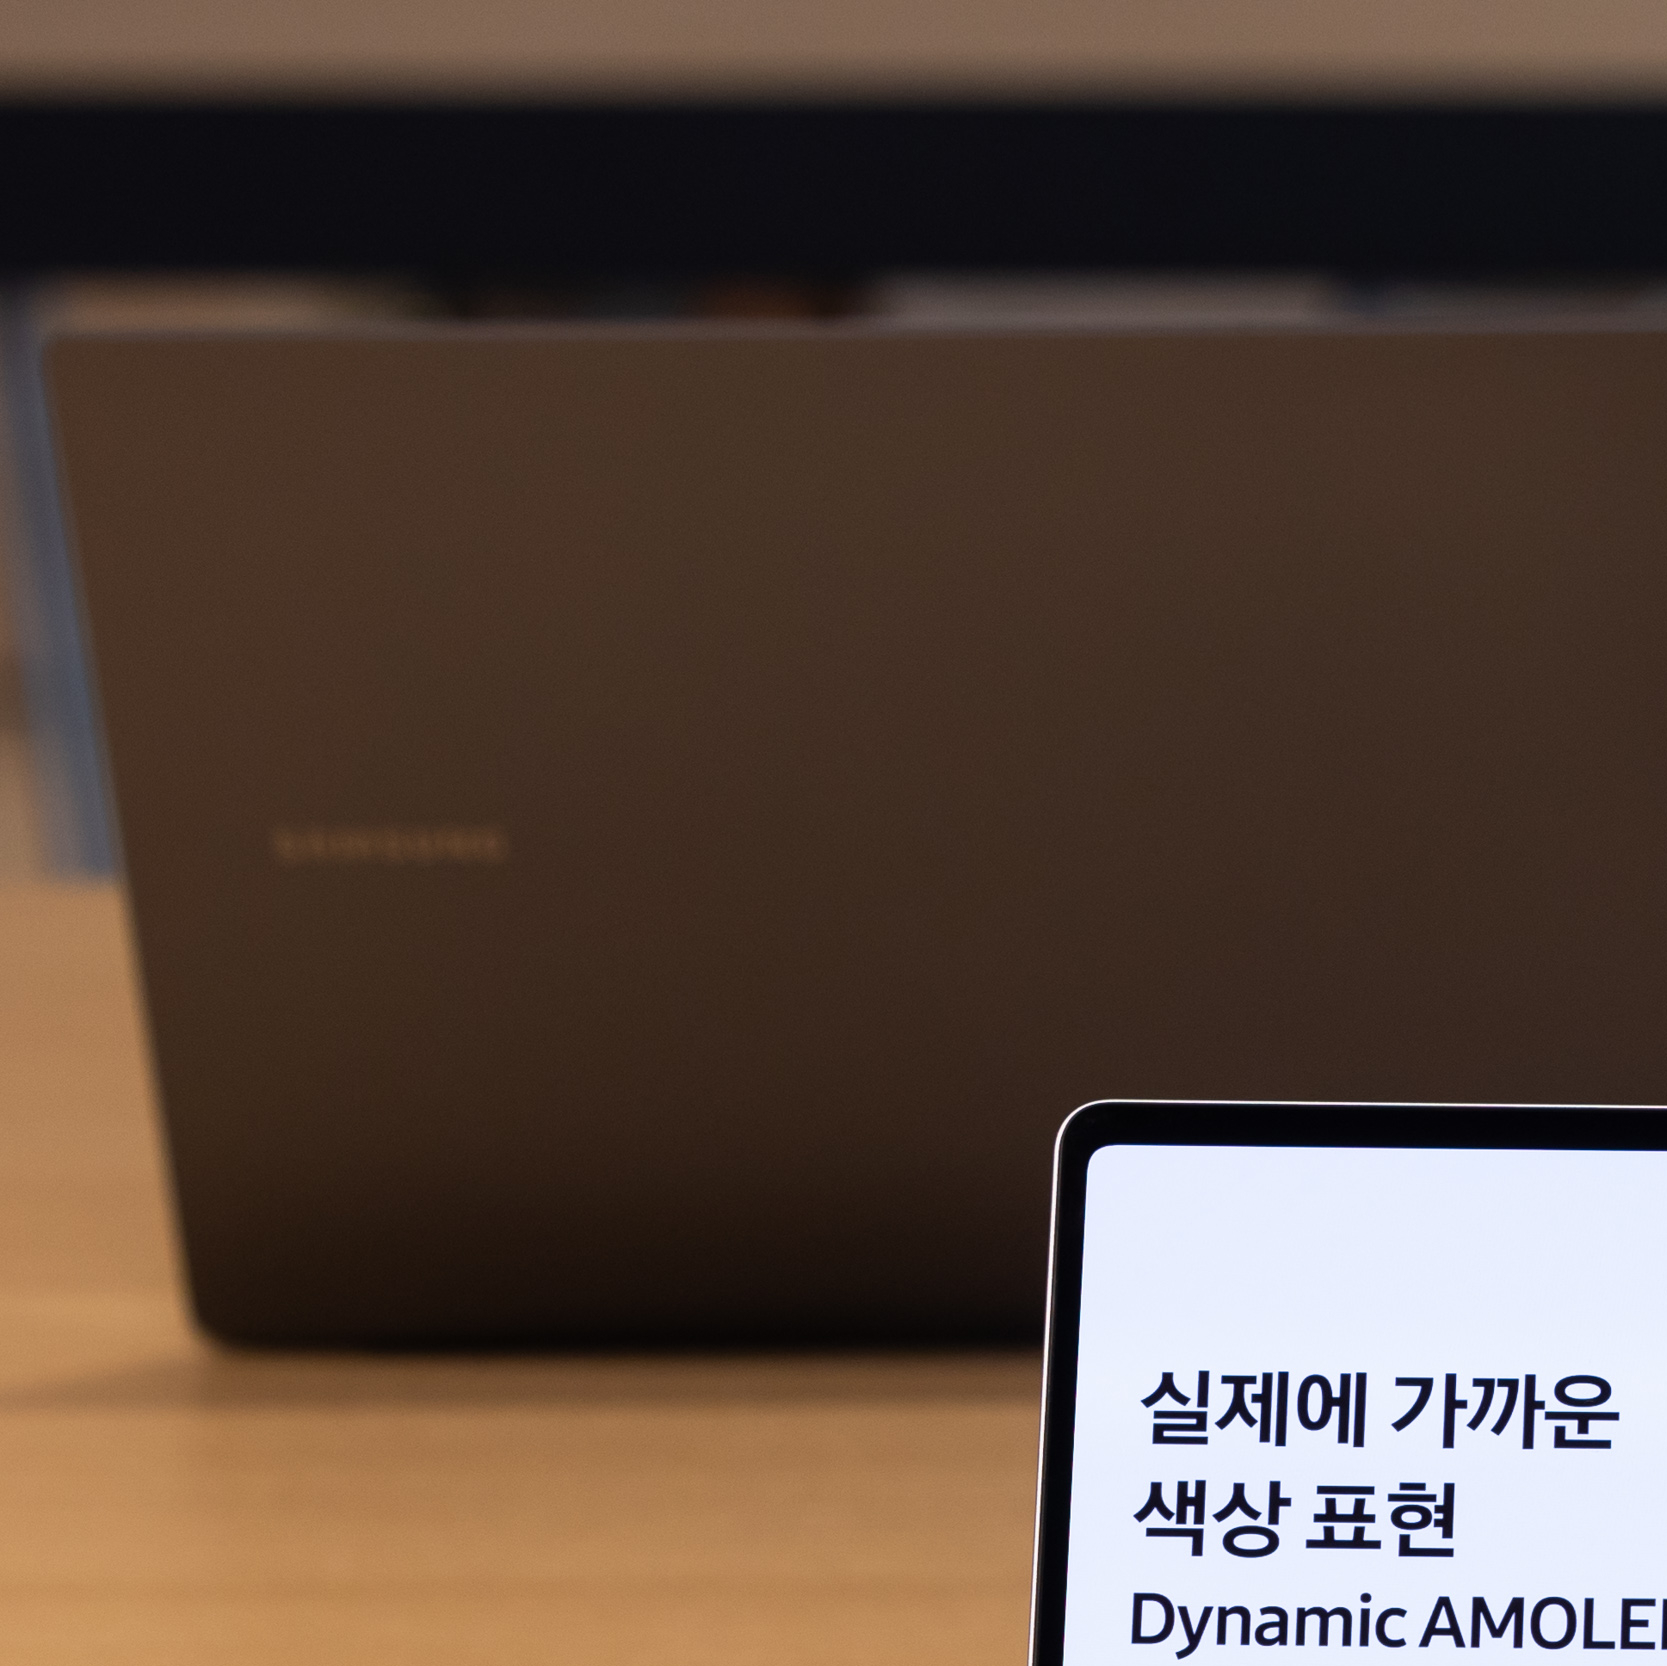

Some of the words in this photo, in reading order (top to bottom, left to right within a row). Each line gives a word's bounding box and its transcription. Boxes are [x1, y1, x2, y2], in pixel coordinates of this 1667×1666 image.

[1141, 1370, 1367, 1448] 실제에
[1392, 1373, 1619, 1449] 가까운
[1134, 1480, 1291, 1558] 색상
[1306, 1482, 1455, 1558] 표현
[1132, 1592, 1407, 1660] Dynamic
